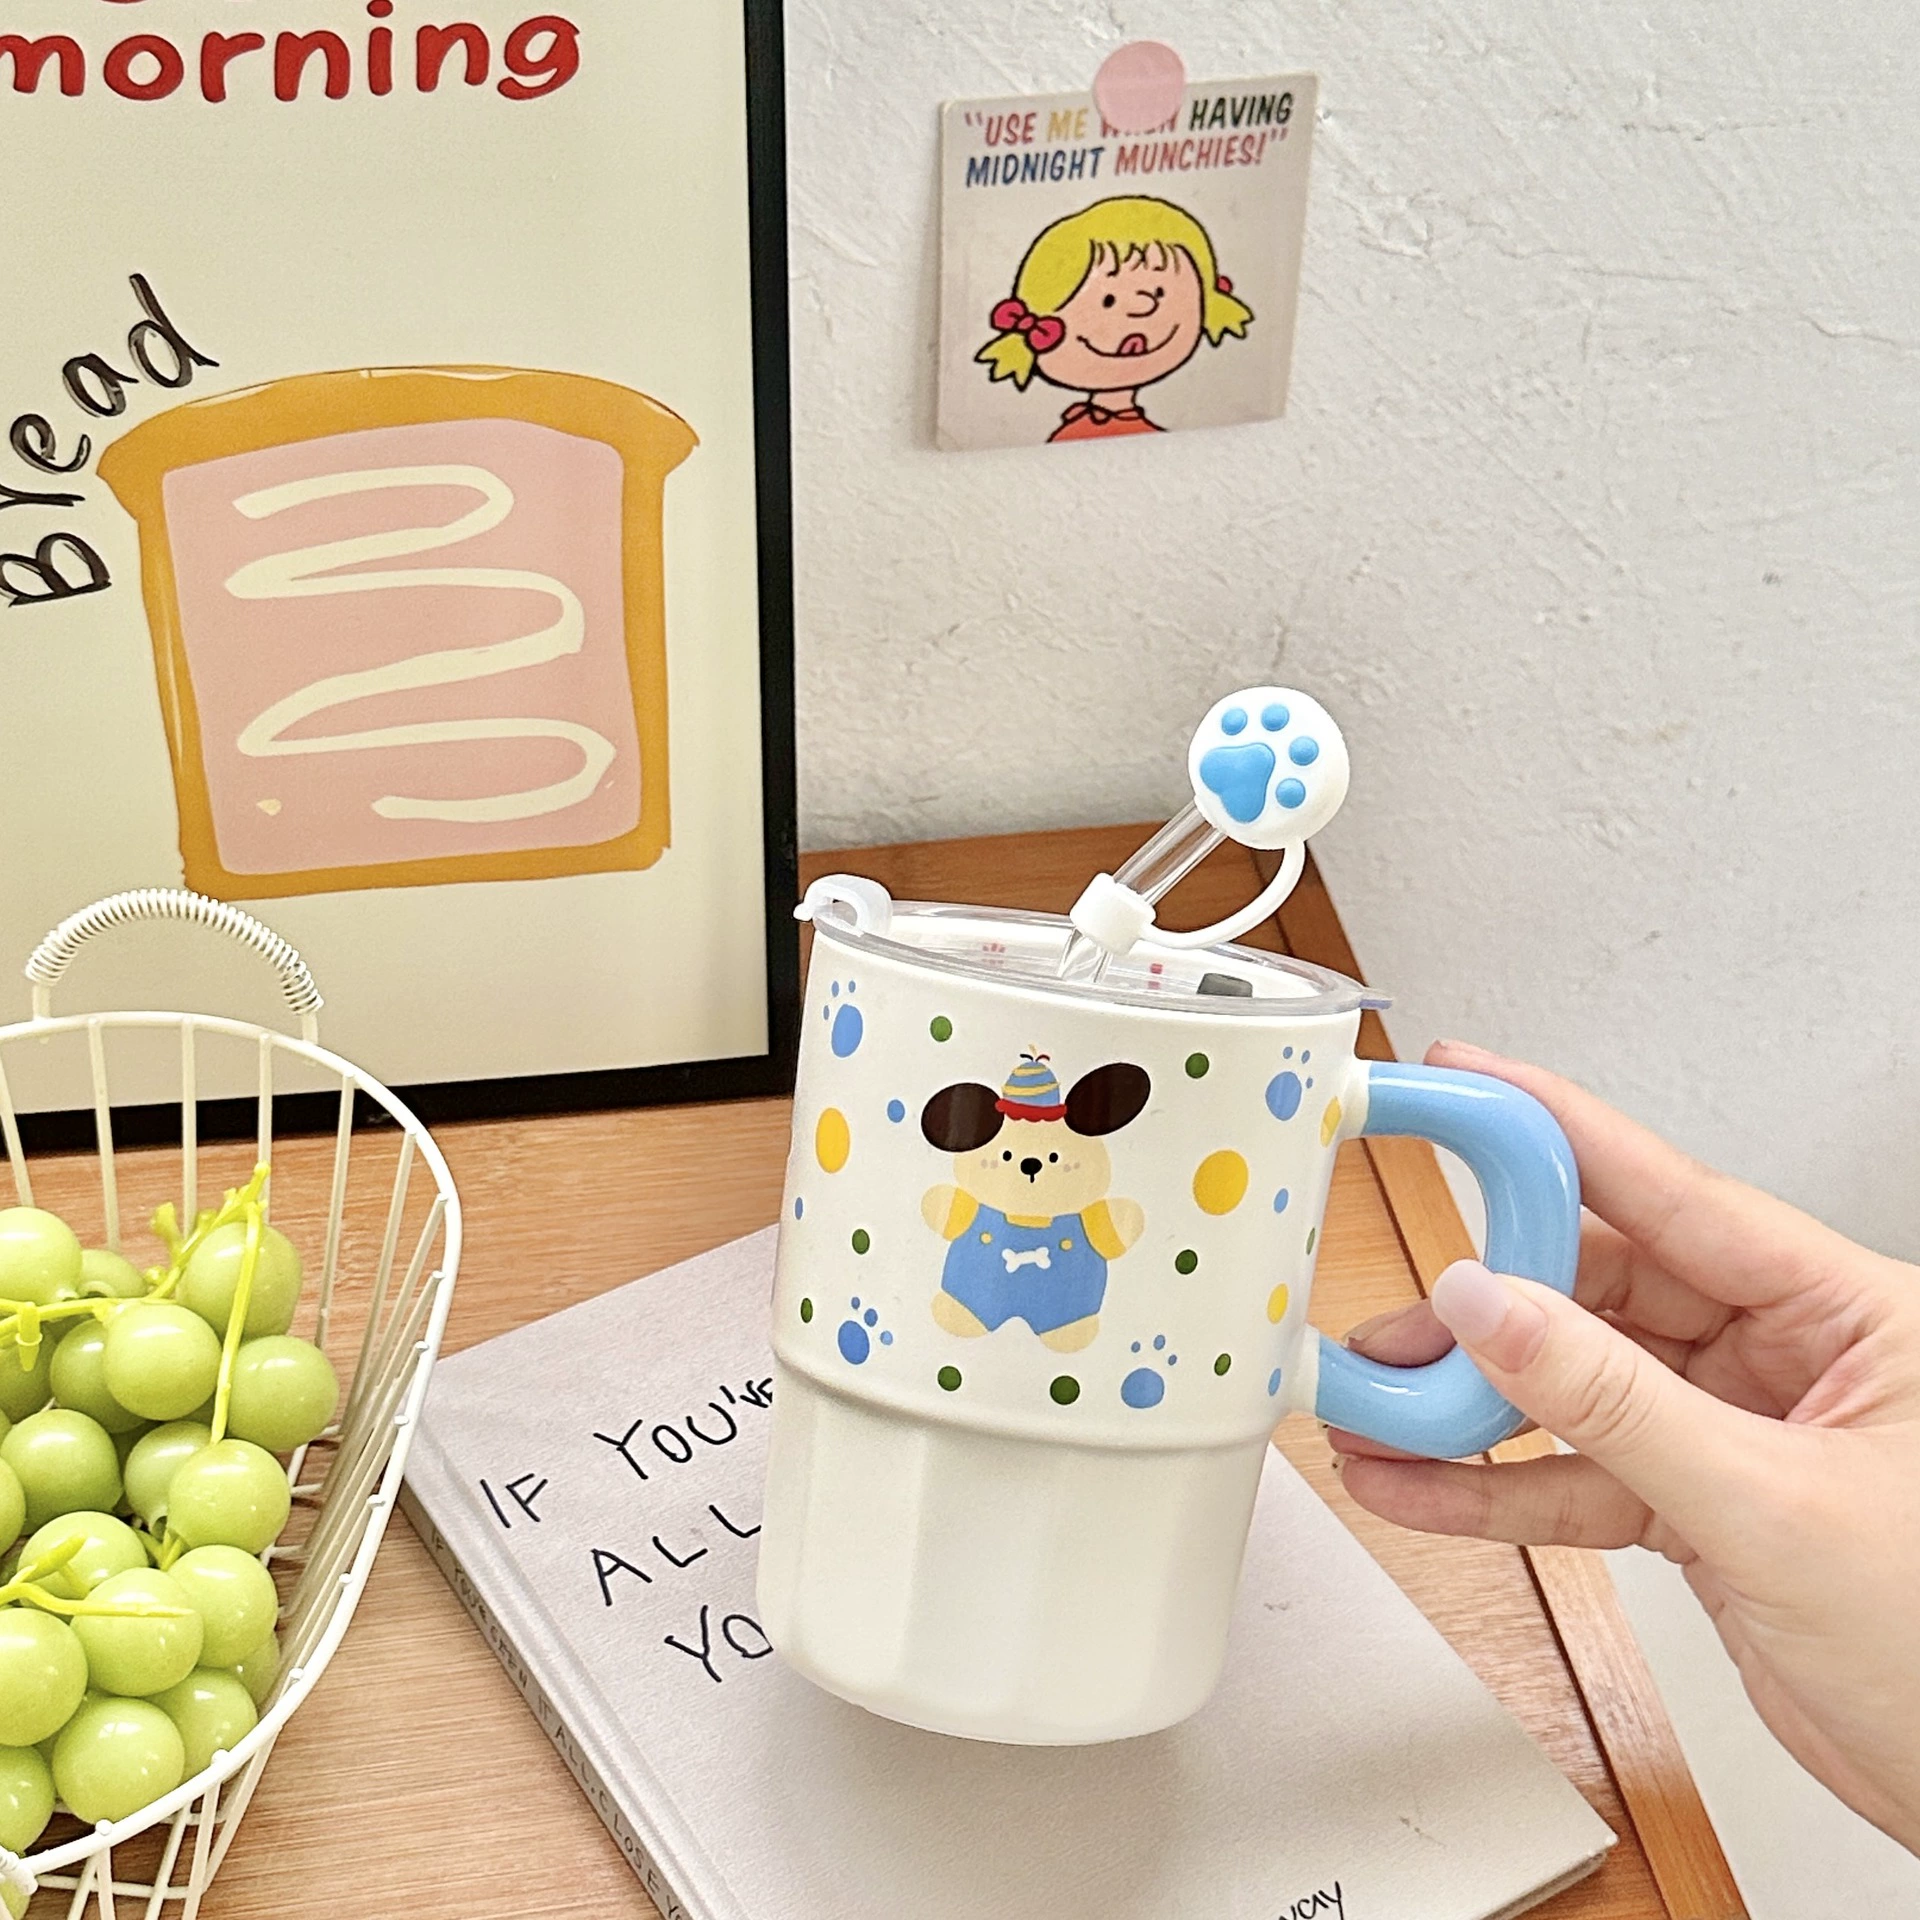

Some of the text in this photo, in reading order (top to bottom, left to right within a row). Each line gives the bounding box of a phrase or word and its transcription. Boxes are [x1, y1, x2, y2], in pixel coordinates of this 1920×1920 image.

[0, 0, 579, 102] morning
[1046, 107, 1089, 142] ME
[1188, 92, 1294, 131] HAVING
[966, 147, 1105, 188] MIDNIGHT
[480, 1472, 549, 1529] IF
[591, 1504, 761, 1606] ALL
